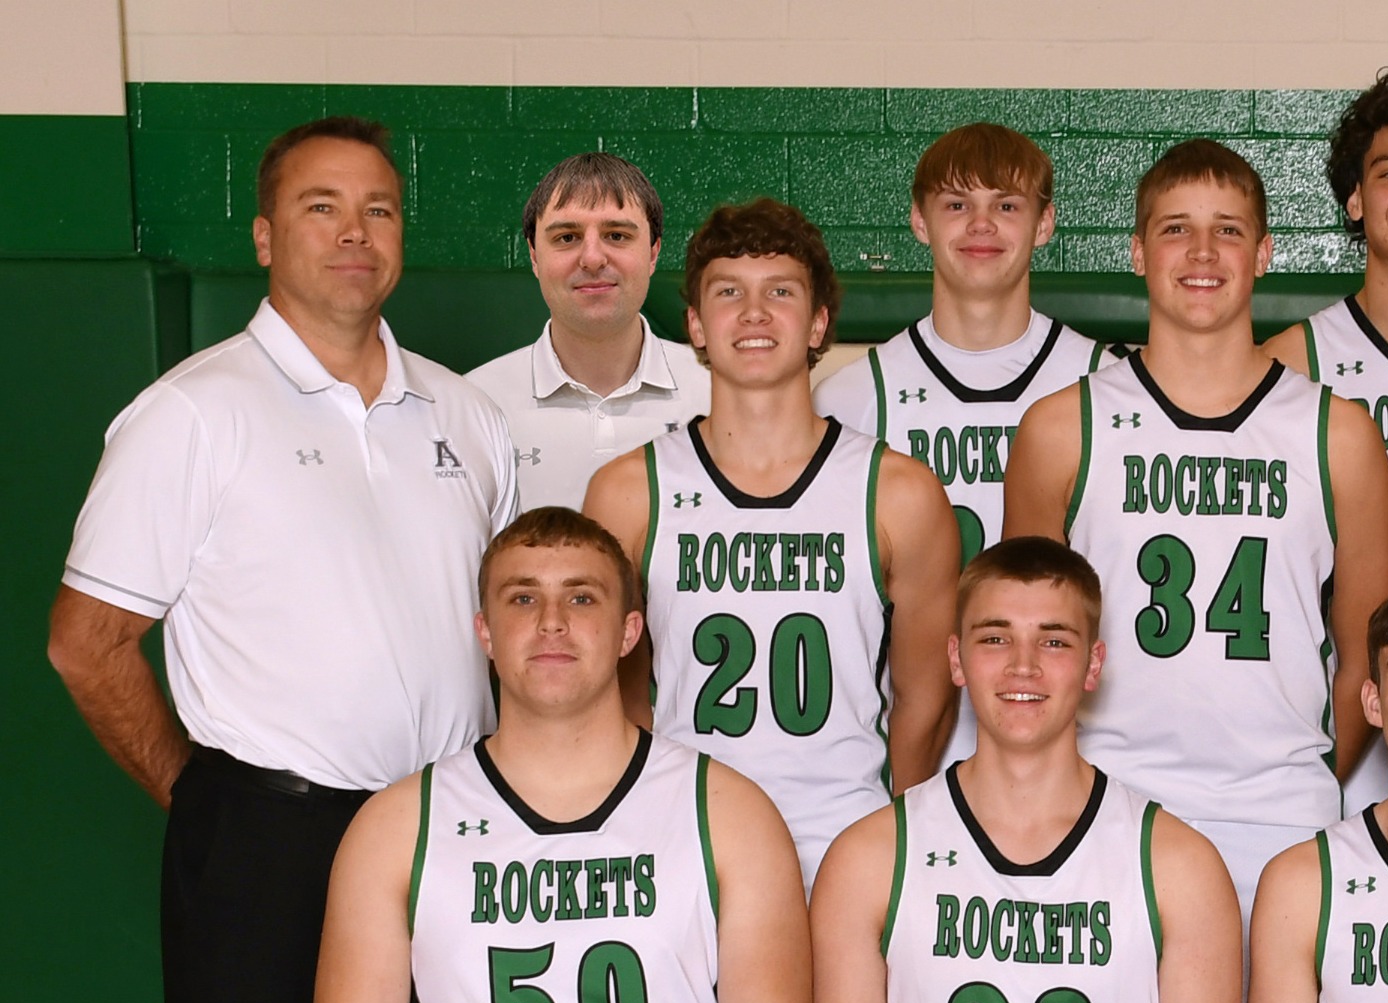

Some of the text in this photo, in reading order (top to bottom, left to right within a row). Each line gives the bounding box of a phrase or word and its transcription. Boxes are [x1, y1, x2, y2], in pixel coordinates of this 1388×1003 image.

[432, 438, 462, 467] A
[907, 425, 1019, 486] ROCK
[1122, 453, 1288, 519] ROCKETS
[676, 531, 845, 593] ROCKETS
[1134, 533, 1271, 662] 34
[692, 612, 833, 738] 20
[471, 853, 657, 924] ROCKETS
[932, 893, 1112, 967] ROCKETS
